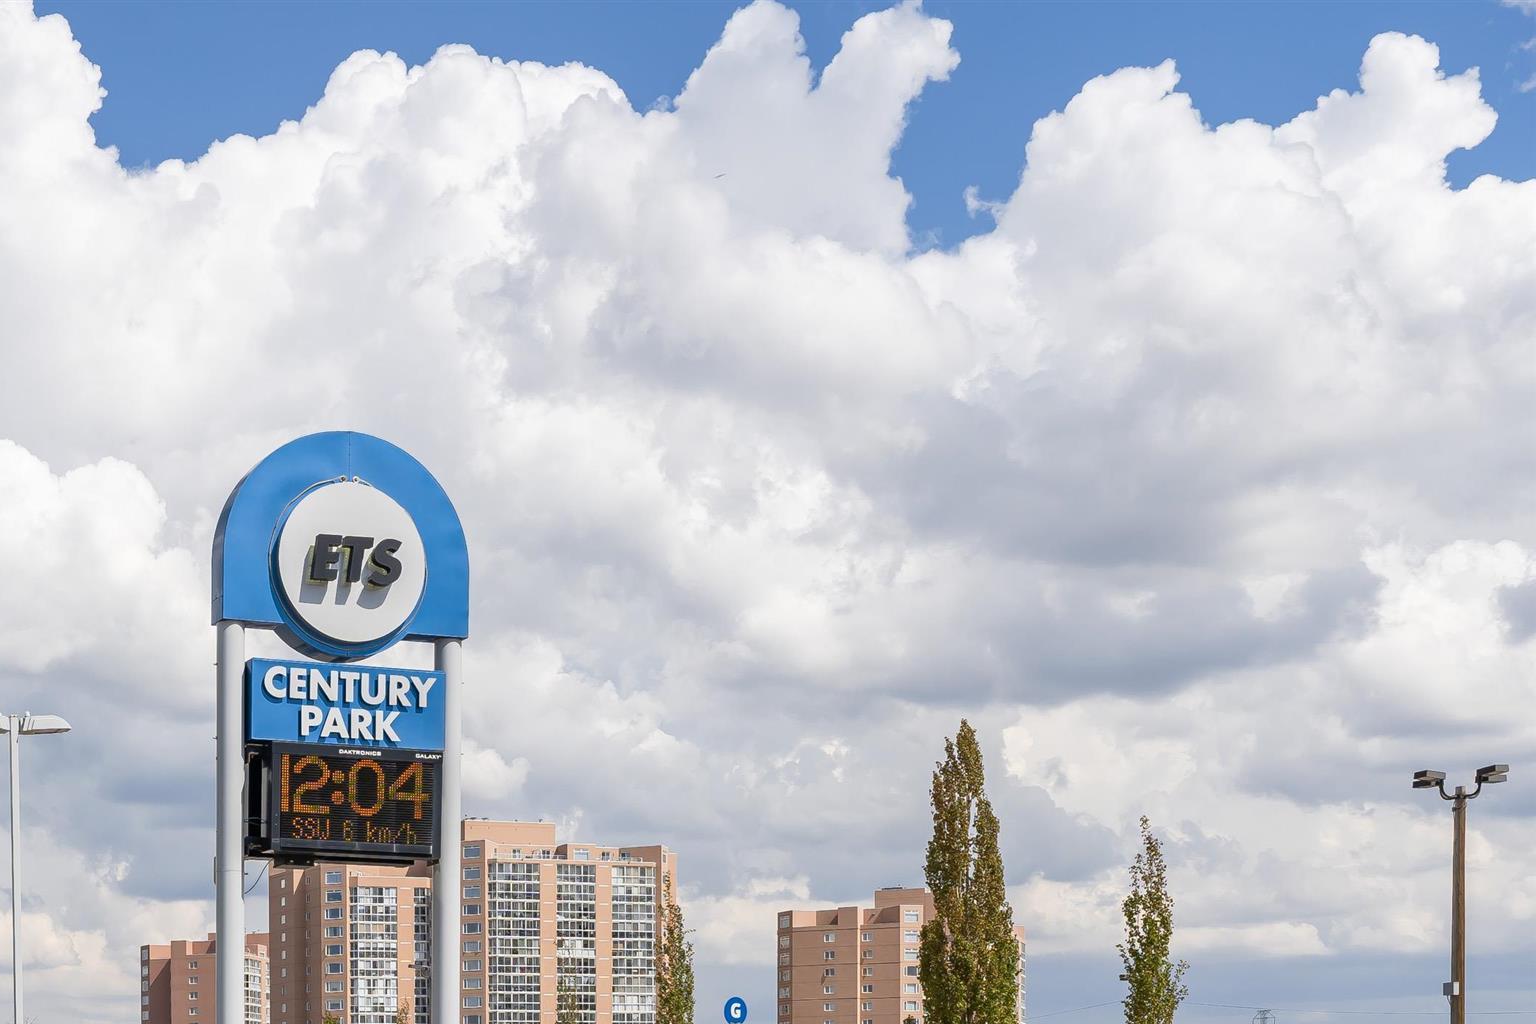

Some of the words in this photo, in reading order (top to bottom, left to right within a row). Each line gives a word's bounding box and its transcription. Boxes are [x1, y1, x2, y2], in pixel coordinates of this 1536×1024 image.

[309, 533, 402, 588] ETS
[263, 665, 437, 709] CENTURY
[300, 704, 401, 742] PARK
[338, 748, 382, 757] DAKTRONICS
[280, 753, 431, 821] 12:04
[366, 820, 418, 846] km/h
[730, 1002, 742, 1019] G
